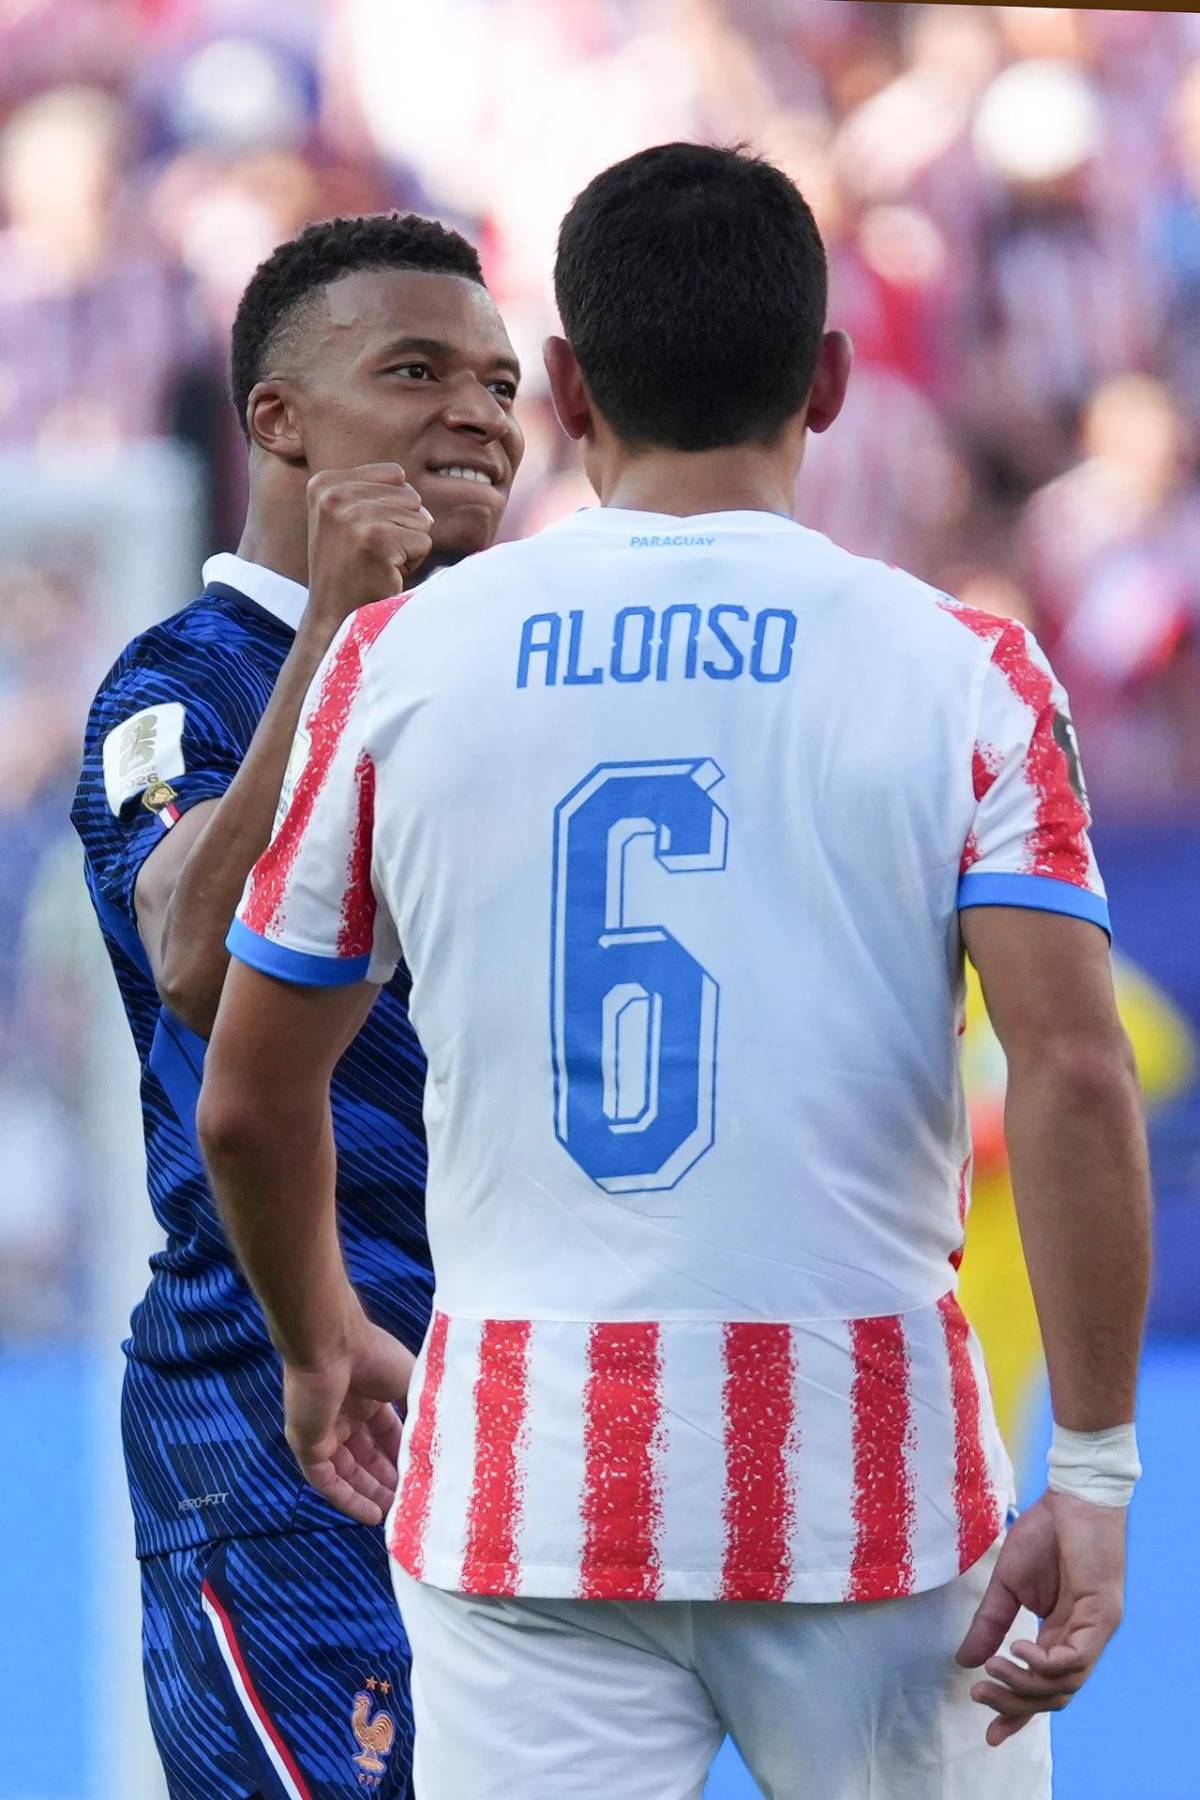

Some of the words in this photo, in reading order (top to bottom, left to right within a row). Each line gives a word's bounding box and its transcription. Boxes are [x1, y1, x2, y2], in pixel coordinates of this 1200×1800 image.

[630, 536, 715, 547] PARAGUAY
[516, 603, 798, 689] ALONSO
[551, 757, 729, 1194] 6
